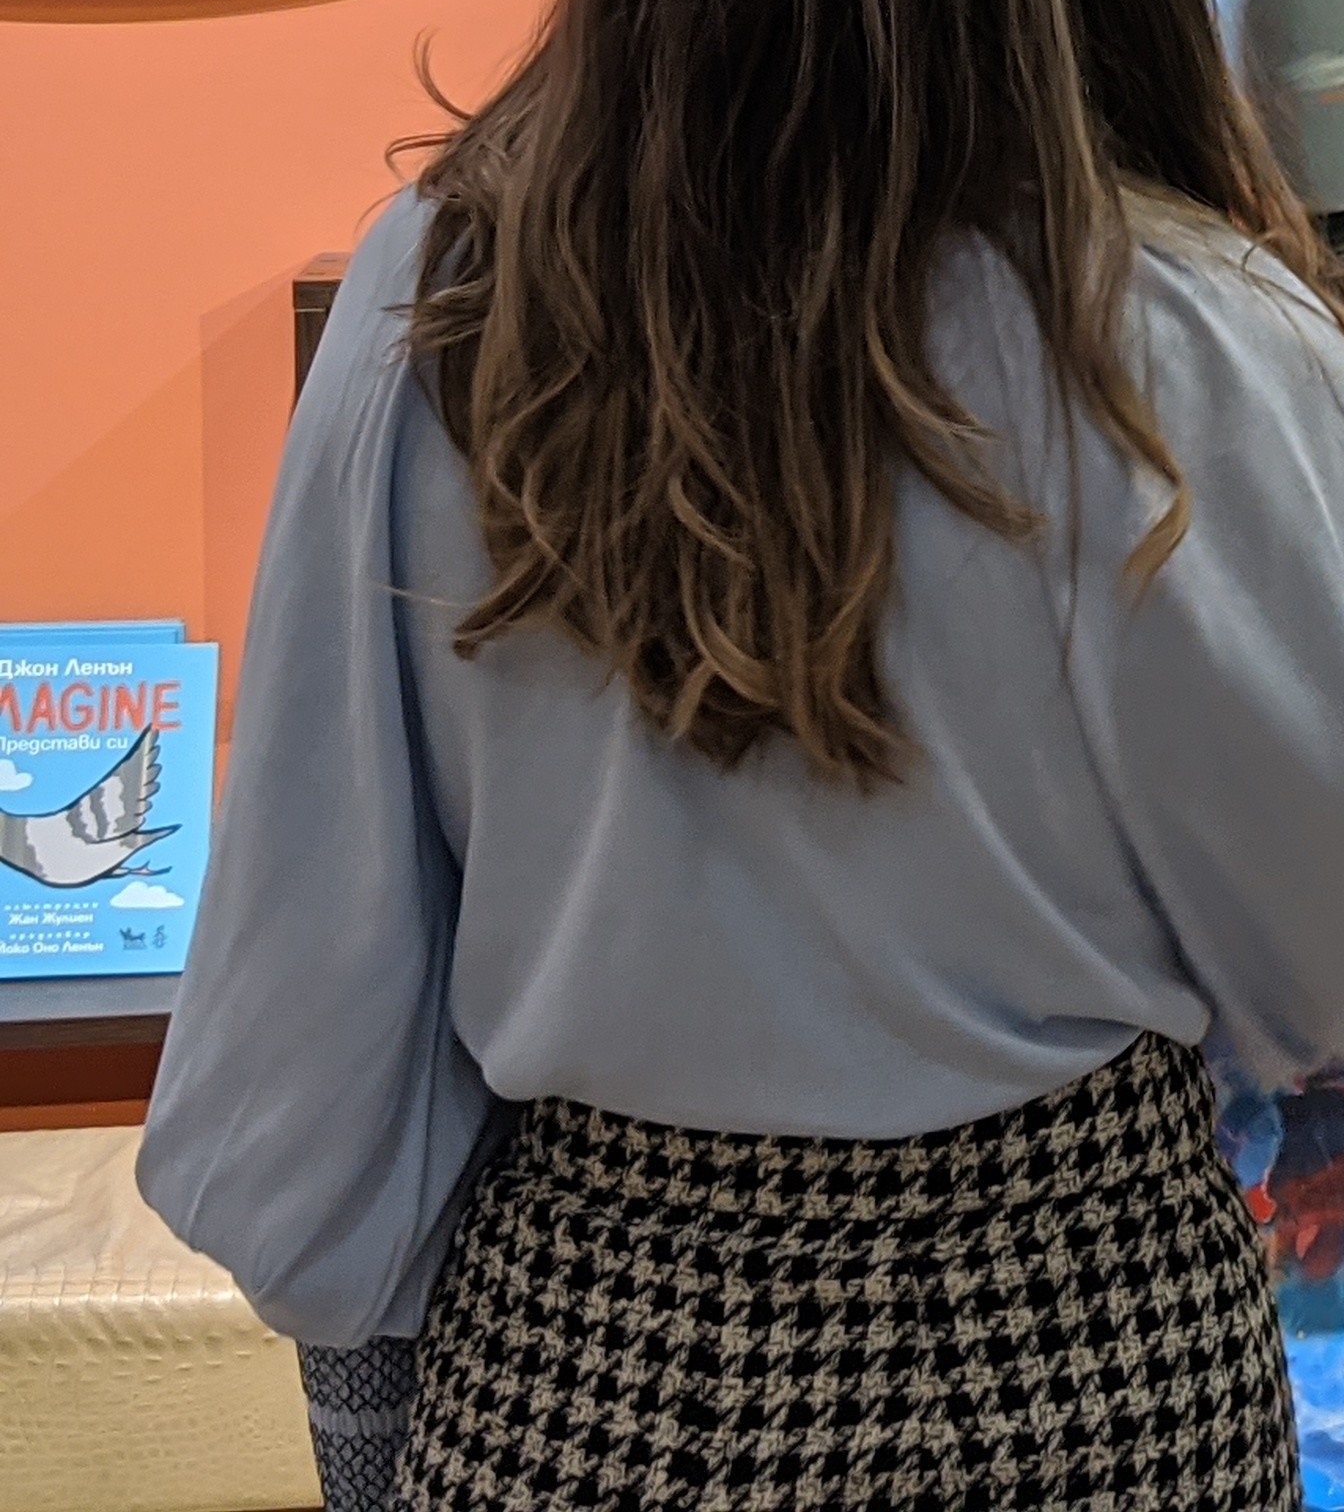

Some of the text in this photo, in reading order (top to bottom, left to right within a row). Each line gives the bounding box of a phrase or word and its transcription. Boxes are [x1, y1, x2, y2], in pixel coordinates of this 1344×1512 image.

[0, 658, 133, 679] Джон Ленън
[107, 737, 128, 749] си
[8, 914, 39, 925] Жан
[33, 941, 60, 953] Оно
